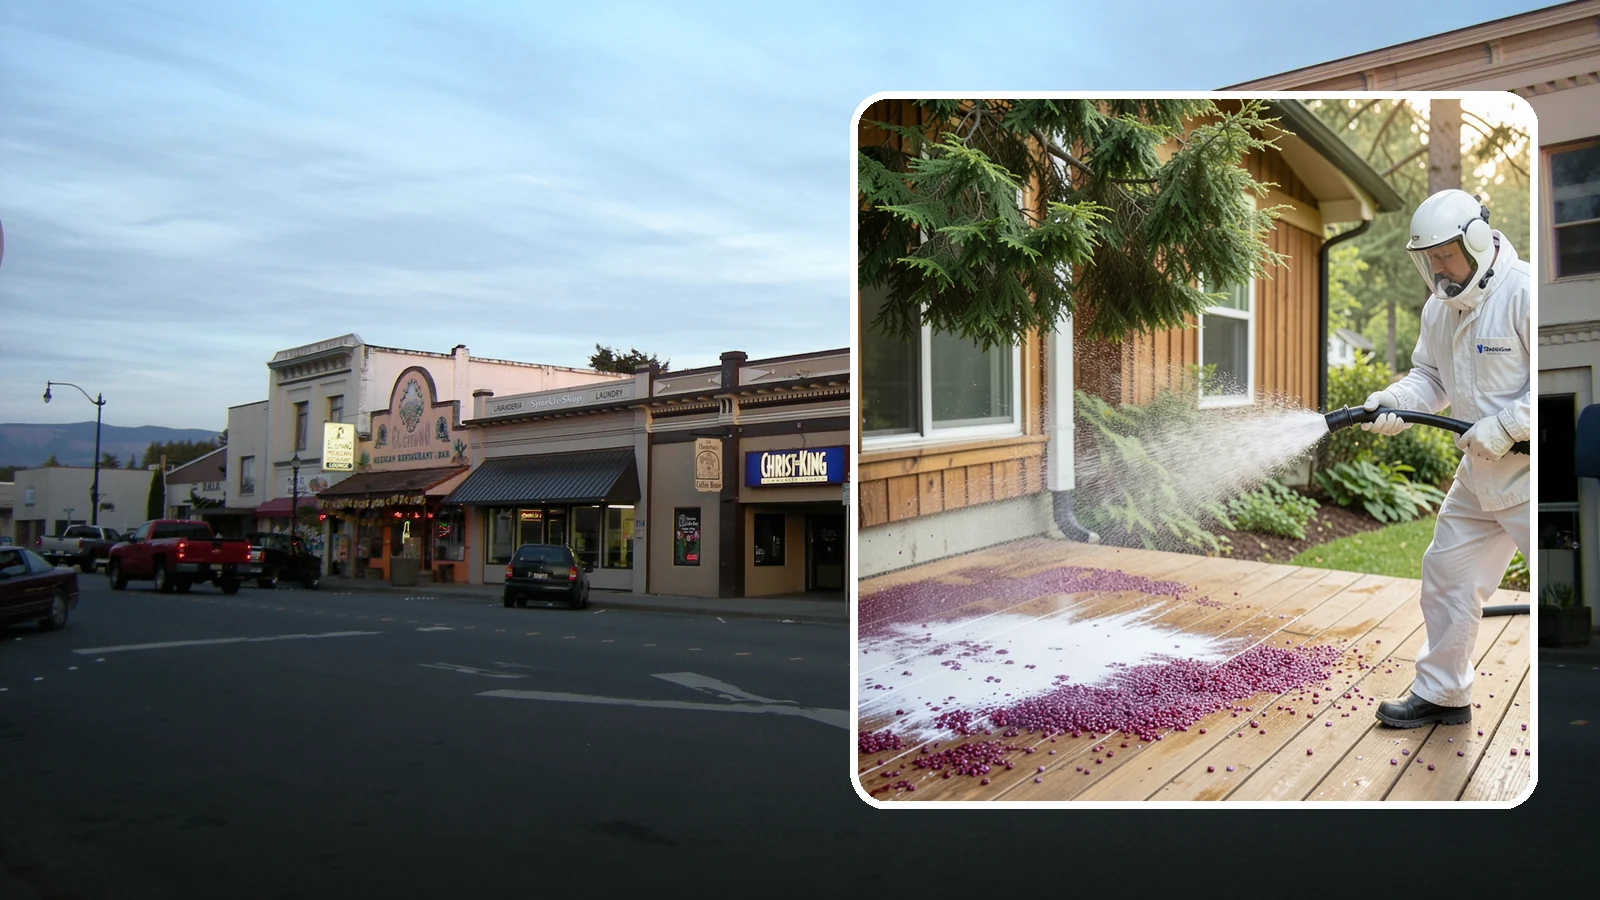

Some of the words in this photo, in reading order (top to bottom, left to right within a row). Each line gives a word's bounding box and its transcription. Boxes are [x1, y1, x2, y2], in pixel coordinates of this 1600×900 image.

[595, 389, 623, 400] LAUNDRY
[493, 402, 522, 413] LAVANDERIA
[373, 455, 396, 464] MEXICAN
[397, 451, 433, 462] RESTAURANT
[437, 450, 450, 459] BAR
[761, 452, 797, 478] CHRIST
[799, 450, 827, 476] KING
